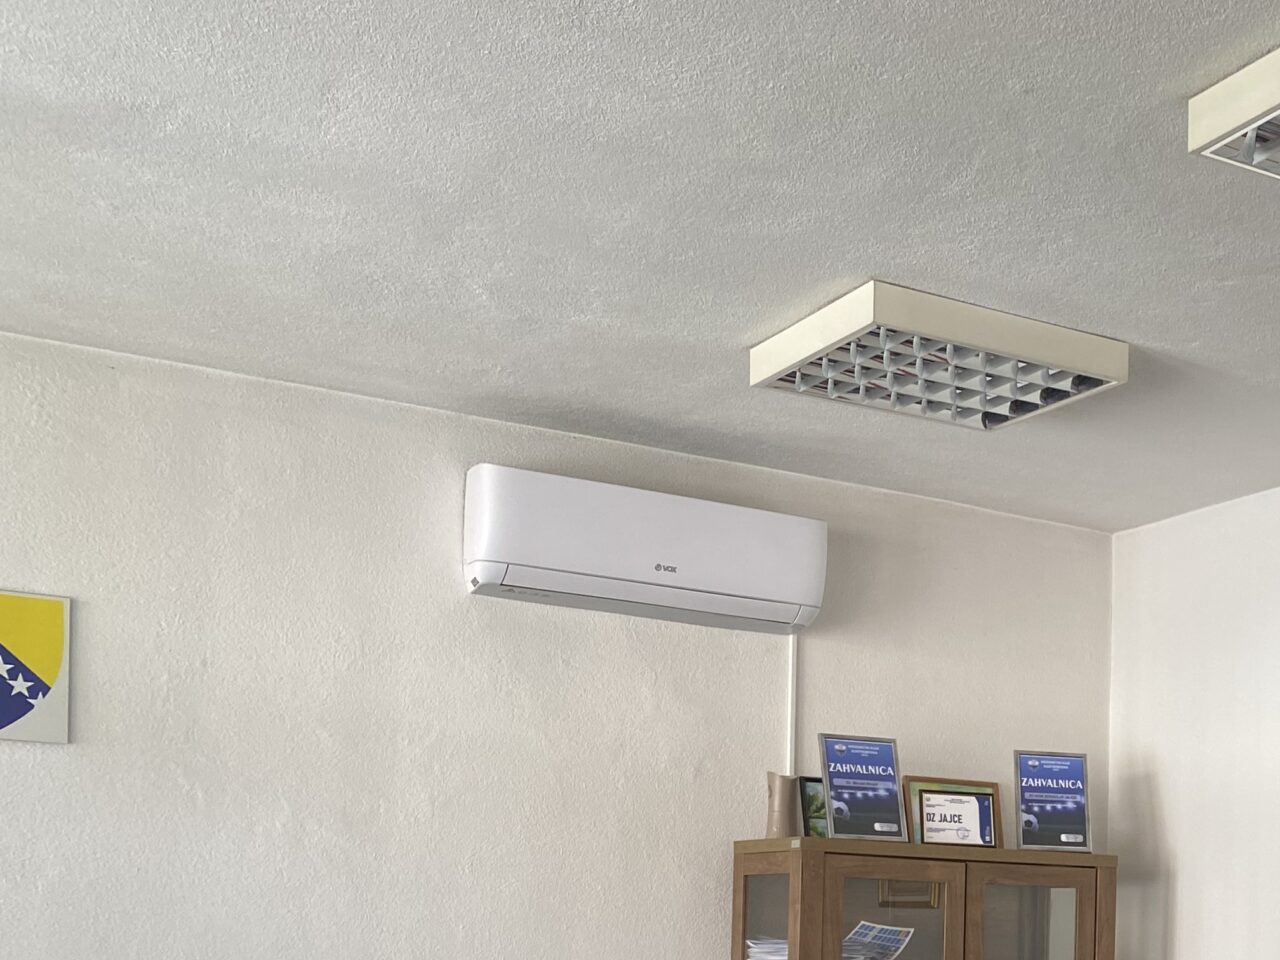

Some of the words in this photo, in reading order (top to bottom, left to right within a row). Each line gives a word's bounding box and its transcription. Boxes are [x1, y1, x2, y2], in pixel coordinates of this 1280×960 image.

[828, 762, 894, 776] ZAHVALNICA
[1021, 777, 1083, 789] ZAHVALNICA
[926, 812, 935, 823] DZ
[938, 813, 963, 824] JAJCE
